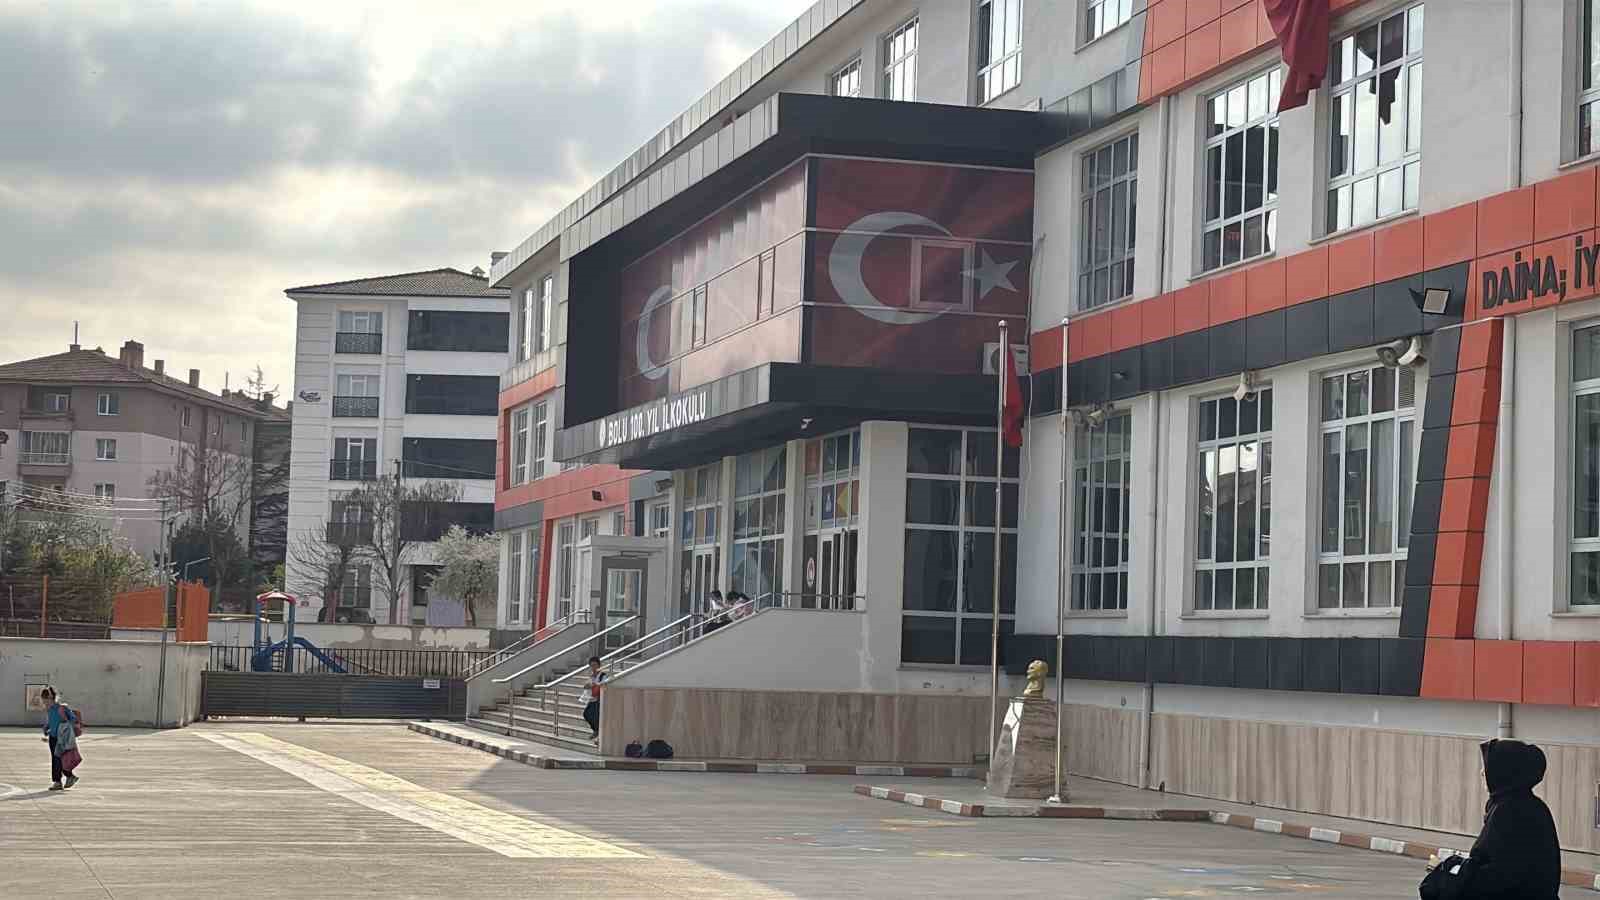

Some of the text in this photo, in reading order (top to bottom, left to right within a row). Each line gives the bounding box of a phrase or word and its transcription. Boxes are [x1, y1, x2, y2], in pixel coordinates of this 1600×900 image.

[1482, 250, 1567, 310] DAİMA;
[608, 391, 706, 446] BOLU 100. YIL İLKOKULU
